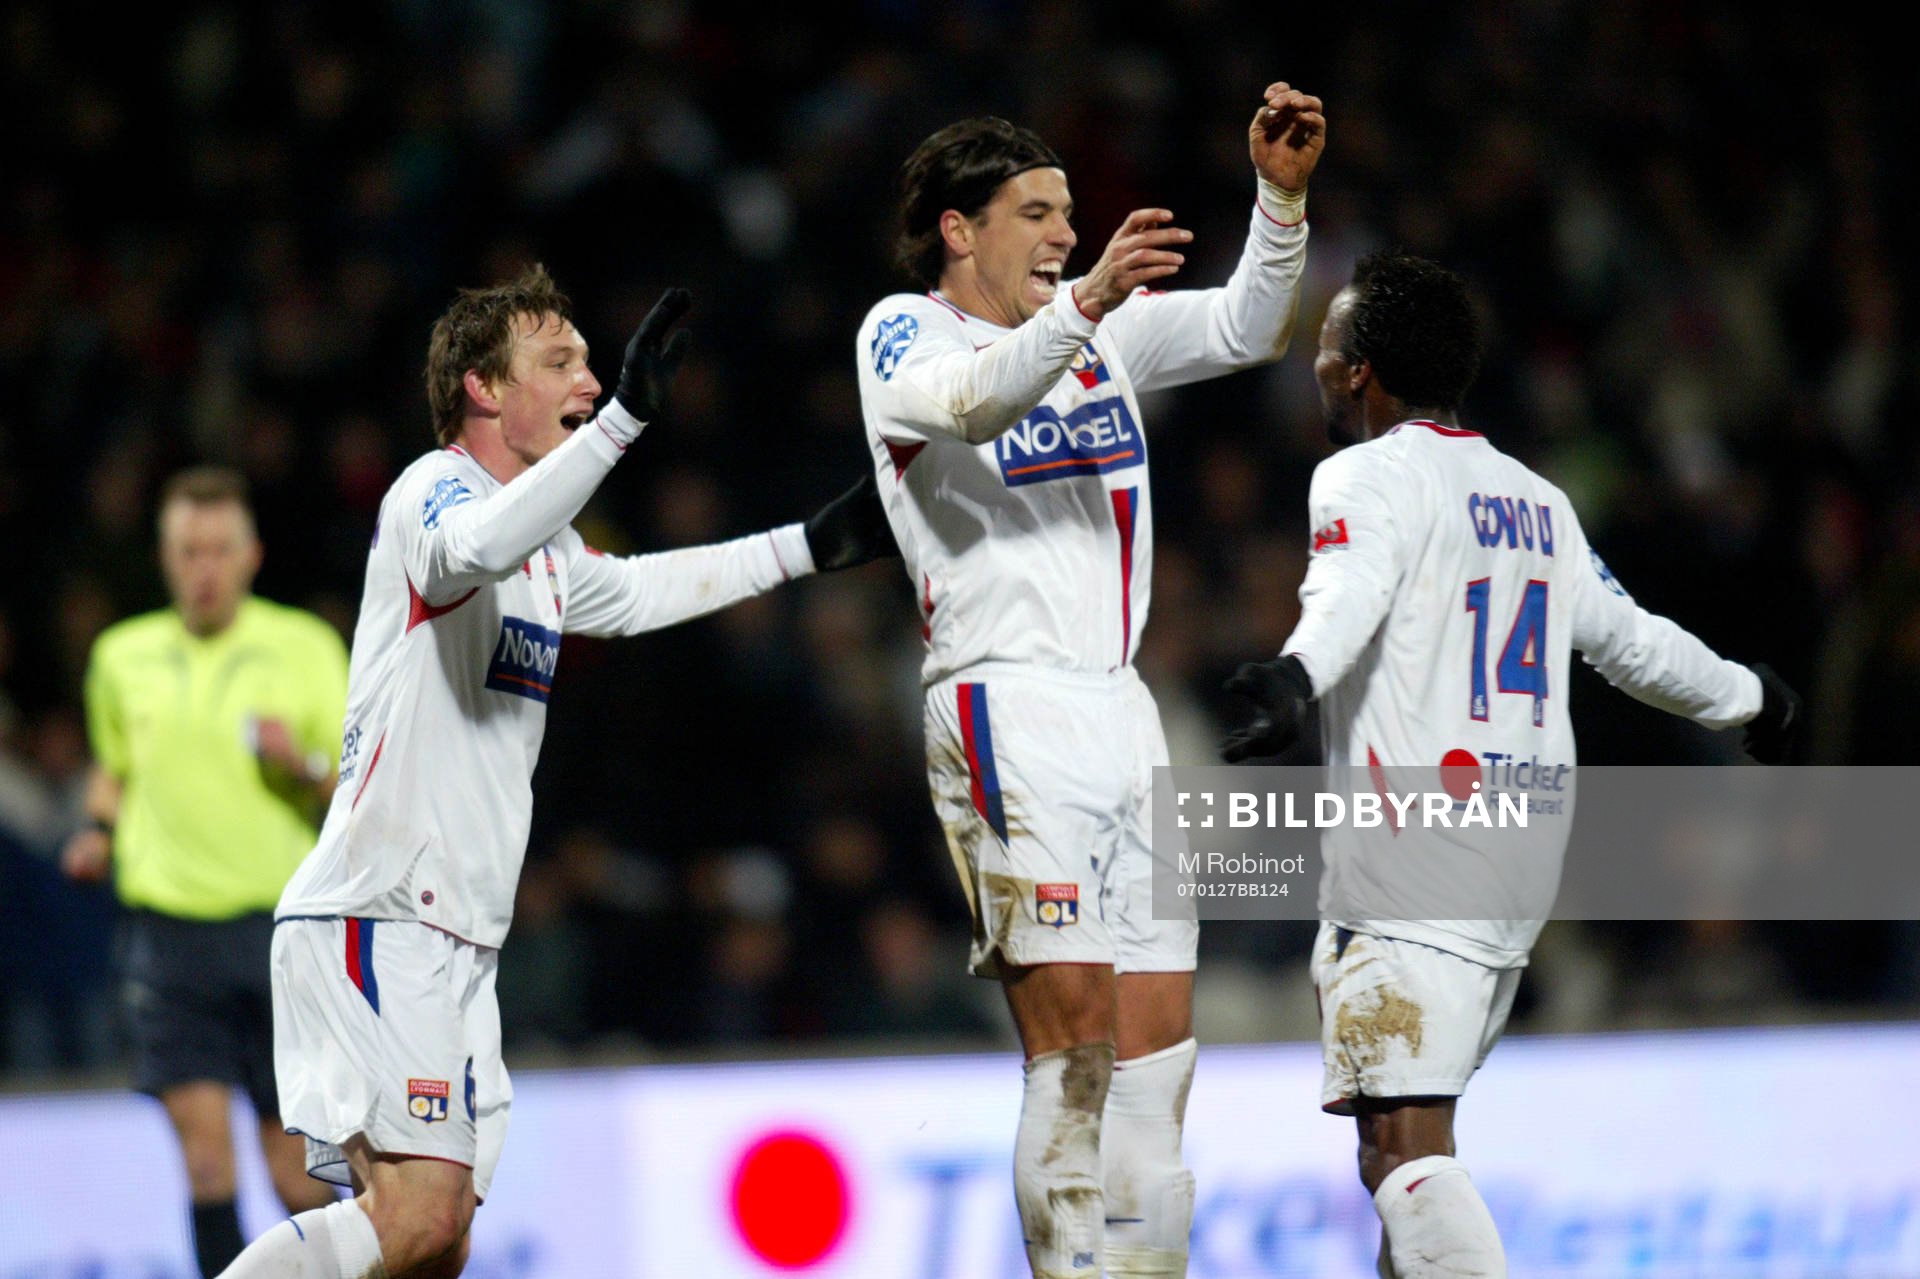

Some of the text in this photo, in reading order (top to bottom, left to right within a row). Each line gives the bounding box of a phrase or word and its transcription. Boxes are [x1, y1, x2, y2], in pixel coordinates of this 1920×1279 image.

[1468, 492, 1554, 556] GOVOU
[1465, 576, 1548, 727] 14
[1482, 752, 1571, 792] Ticket
